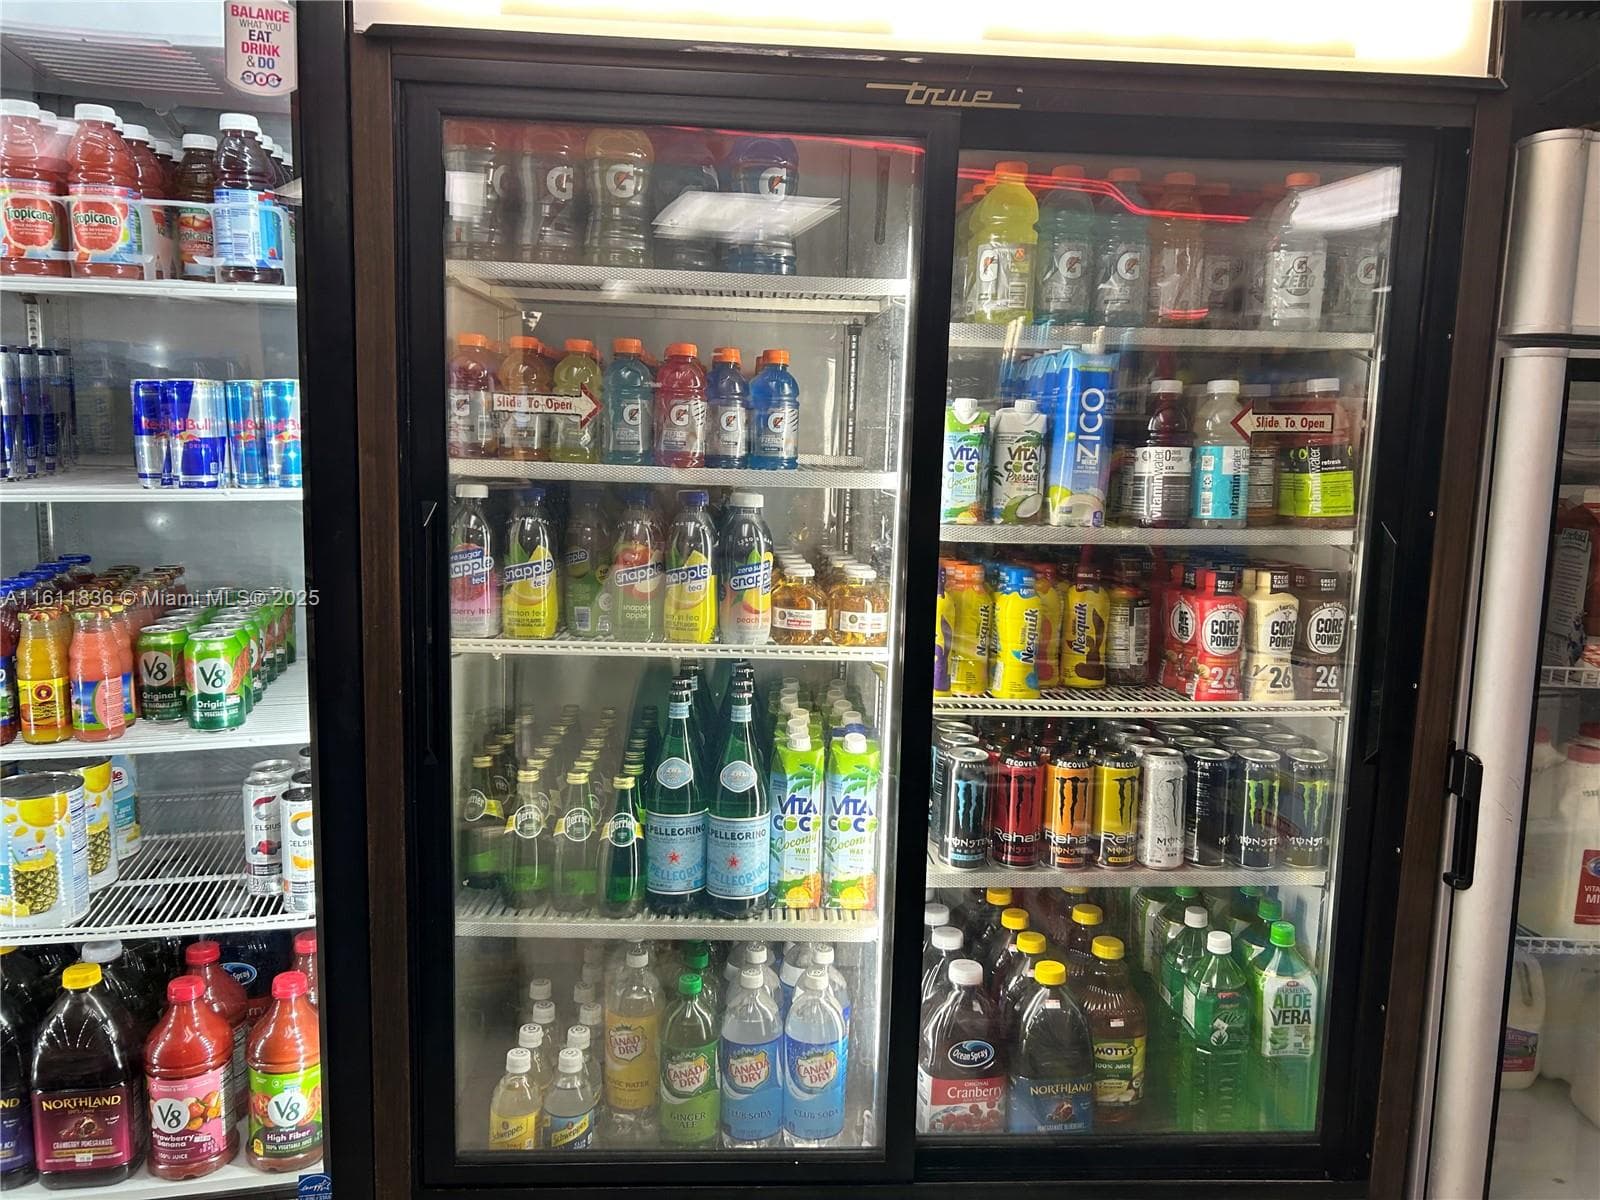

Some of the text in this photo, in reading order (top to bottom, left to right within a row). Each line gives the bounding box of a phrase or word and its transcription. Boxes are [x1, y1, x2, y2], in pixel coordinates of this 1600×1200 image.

[231, 4, 290, 23] BALANCE
[239, 18, 282, 32] WHAT YOU
[249, 29, 272, 43] EAT
[241, 41, 281, 57] DRINK
[246, 55, 275, 70] & DO
[866, 82, 1021, 109] true
[6, 207, 55, 223] Tropicana
[73, 211, 119, 226] Tropicana
[497, 396, 573, 411] Slide To Open
[186, 419, 211, 431] Bull
[1077, 388, 1105, 465] ZICO
[1256, 416, 1325, 430] Slide To Open
[950, 445, 980, 461] VITA
[1008, 445, 1038, 461] VITA
[947, 461, 978, 473] COC
[1004, 461, 1040, 473] COCO
[505, 559, 554, 580] snapple
[616, 564, 662, 584] snapple
[666, 565, 709, 584] napple
[472, 576, 486, 585] tea
[688, 583, 702, 592] tea
[977, 603, 991, 657] Nesquik
[1072, 602, 1087, 655] Nesquik
[1211, 619, 1240, 635] CORE
[1316, 618, 1342, 633] CORE
[1021, 608, 1039, 664] Nesquik
[1210, 635, 1239, 647] POWER
[1315, 633, 1341, 645] POWER
[143, 656, 168, 681] V8
[199, 663, 226, 688] V8
[1316, 665, 1338, 688] 26
[1210, 666, 1236, 689] 26
[1269, 666, 1291, 689] 26
[142, 691, 177, 701] Original
[198, 699, 226, 710] Origin
[777, 794, 818, 815] VITA
[831, 795, 874, 816] VITA
[252, 822, 281, 832] ELSIUS
[773, 815, 822, 833] COCO
[828, 815, 879, 833] COCO
[1273, 992, 1312, 1008] ALOE
[1269, 1008, 1312, 1026] VERA
[618, 1045, 639, 1055] DRY
[953, 1048, 988, 1061] Ocean Spray
[667, 1062, 709, 1081] CANADA
[729, 1059, 769, 1078] CANADA
[797, 1058, 838, 1078] CANADA
[680, 1076, 701, 1088] DRY
[741, 1071, 762, 1083] DRY
[810, 1071, 831, 1084] DRY
[947, 1086, 1002, 1100] Cranberry
[1030, 1082, 1093, 1096] NORTHLAND
[42, 1095, 121, 1111] NORTHLAND
[274, 1096, 300, 1121] V8
[157, 1103, 182, 1129] V8
[670, 1111, 706, 1121] GINGER
[152, 1130, 194, 1142] Strawberry
[267, 1129, 311, 1143] High Fiber
